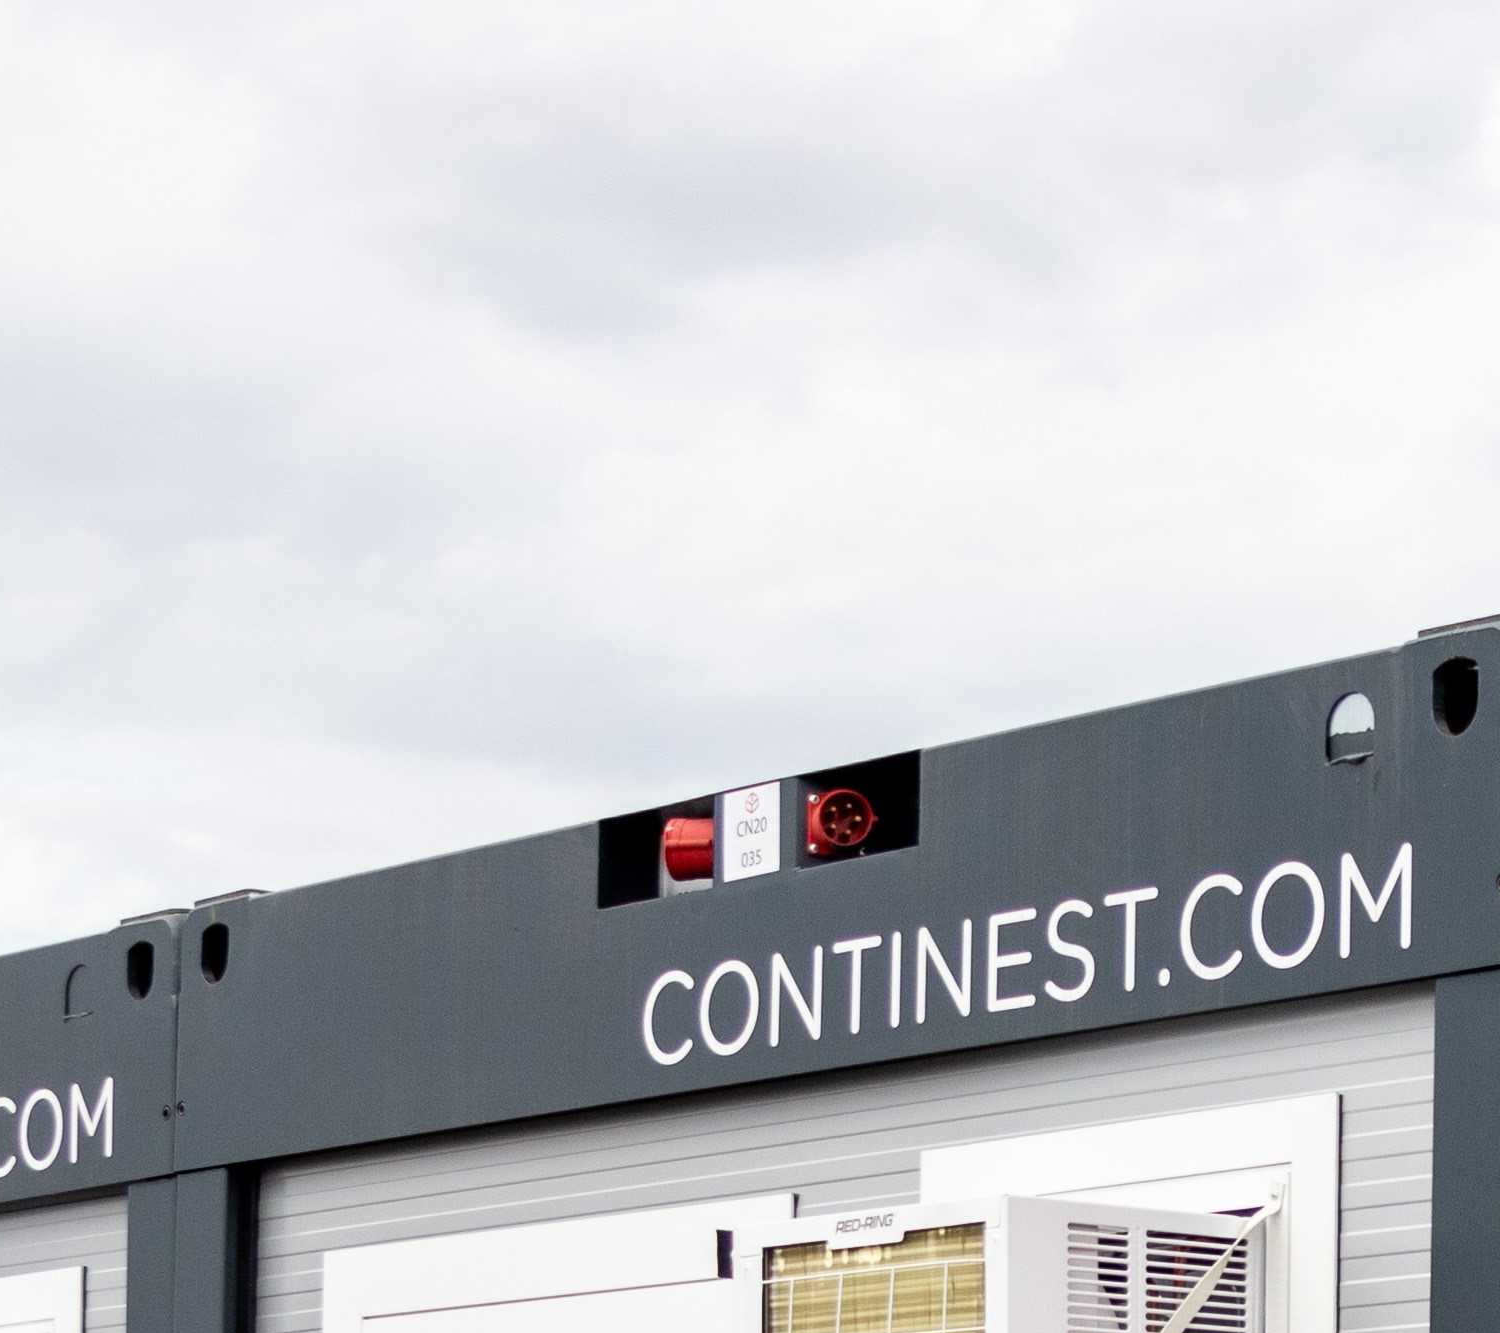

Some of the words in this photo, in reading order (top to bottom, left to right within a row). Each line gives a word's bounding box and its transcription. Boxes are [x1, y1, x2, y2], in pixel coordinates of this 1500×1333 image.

[736, 816, 768, 838] CN20
[741, 849, 763, 868] 035
[642, 842, 1413, 1066] CONTINEST.COM
[836, 1213, 894, 1233] RED-RING
